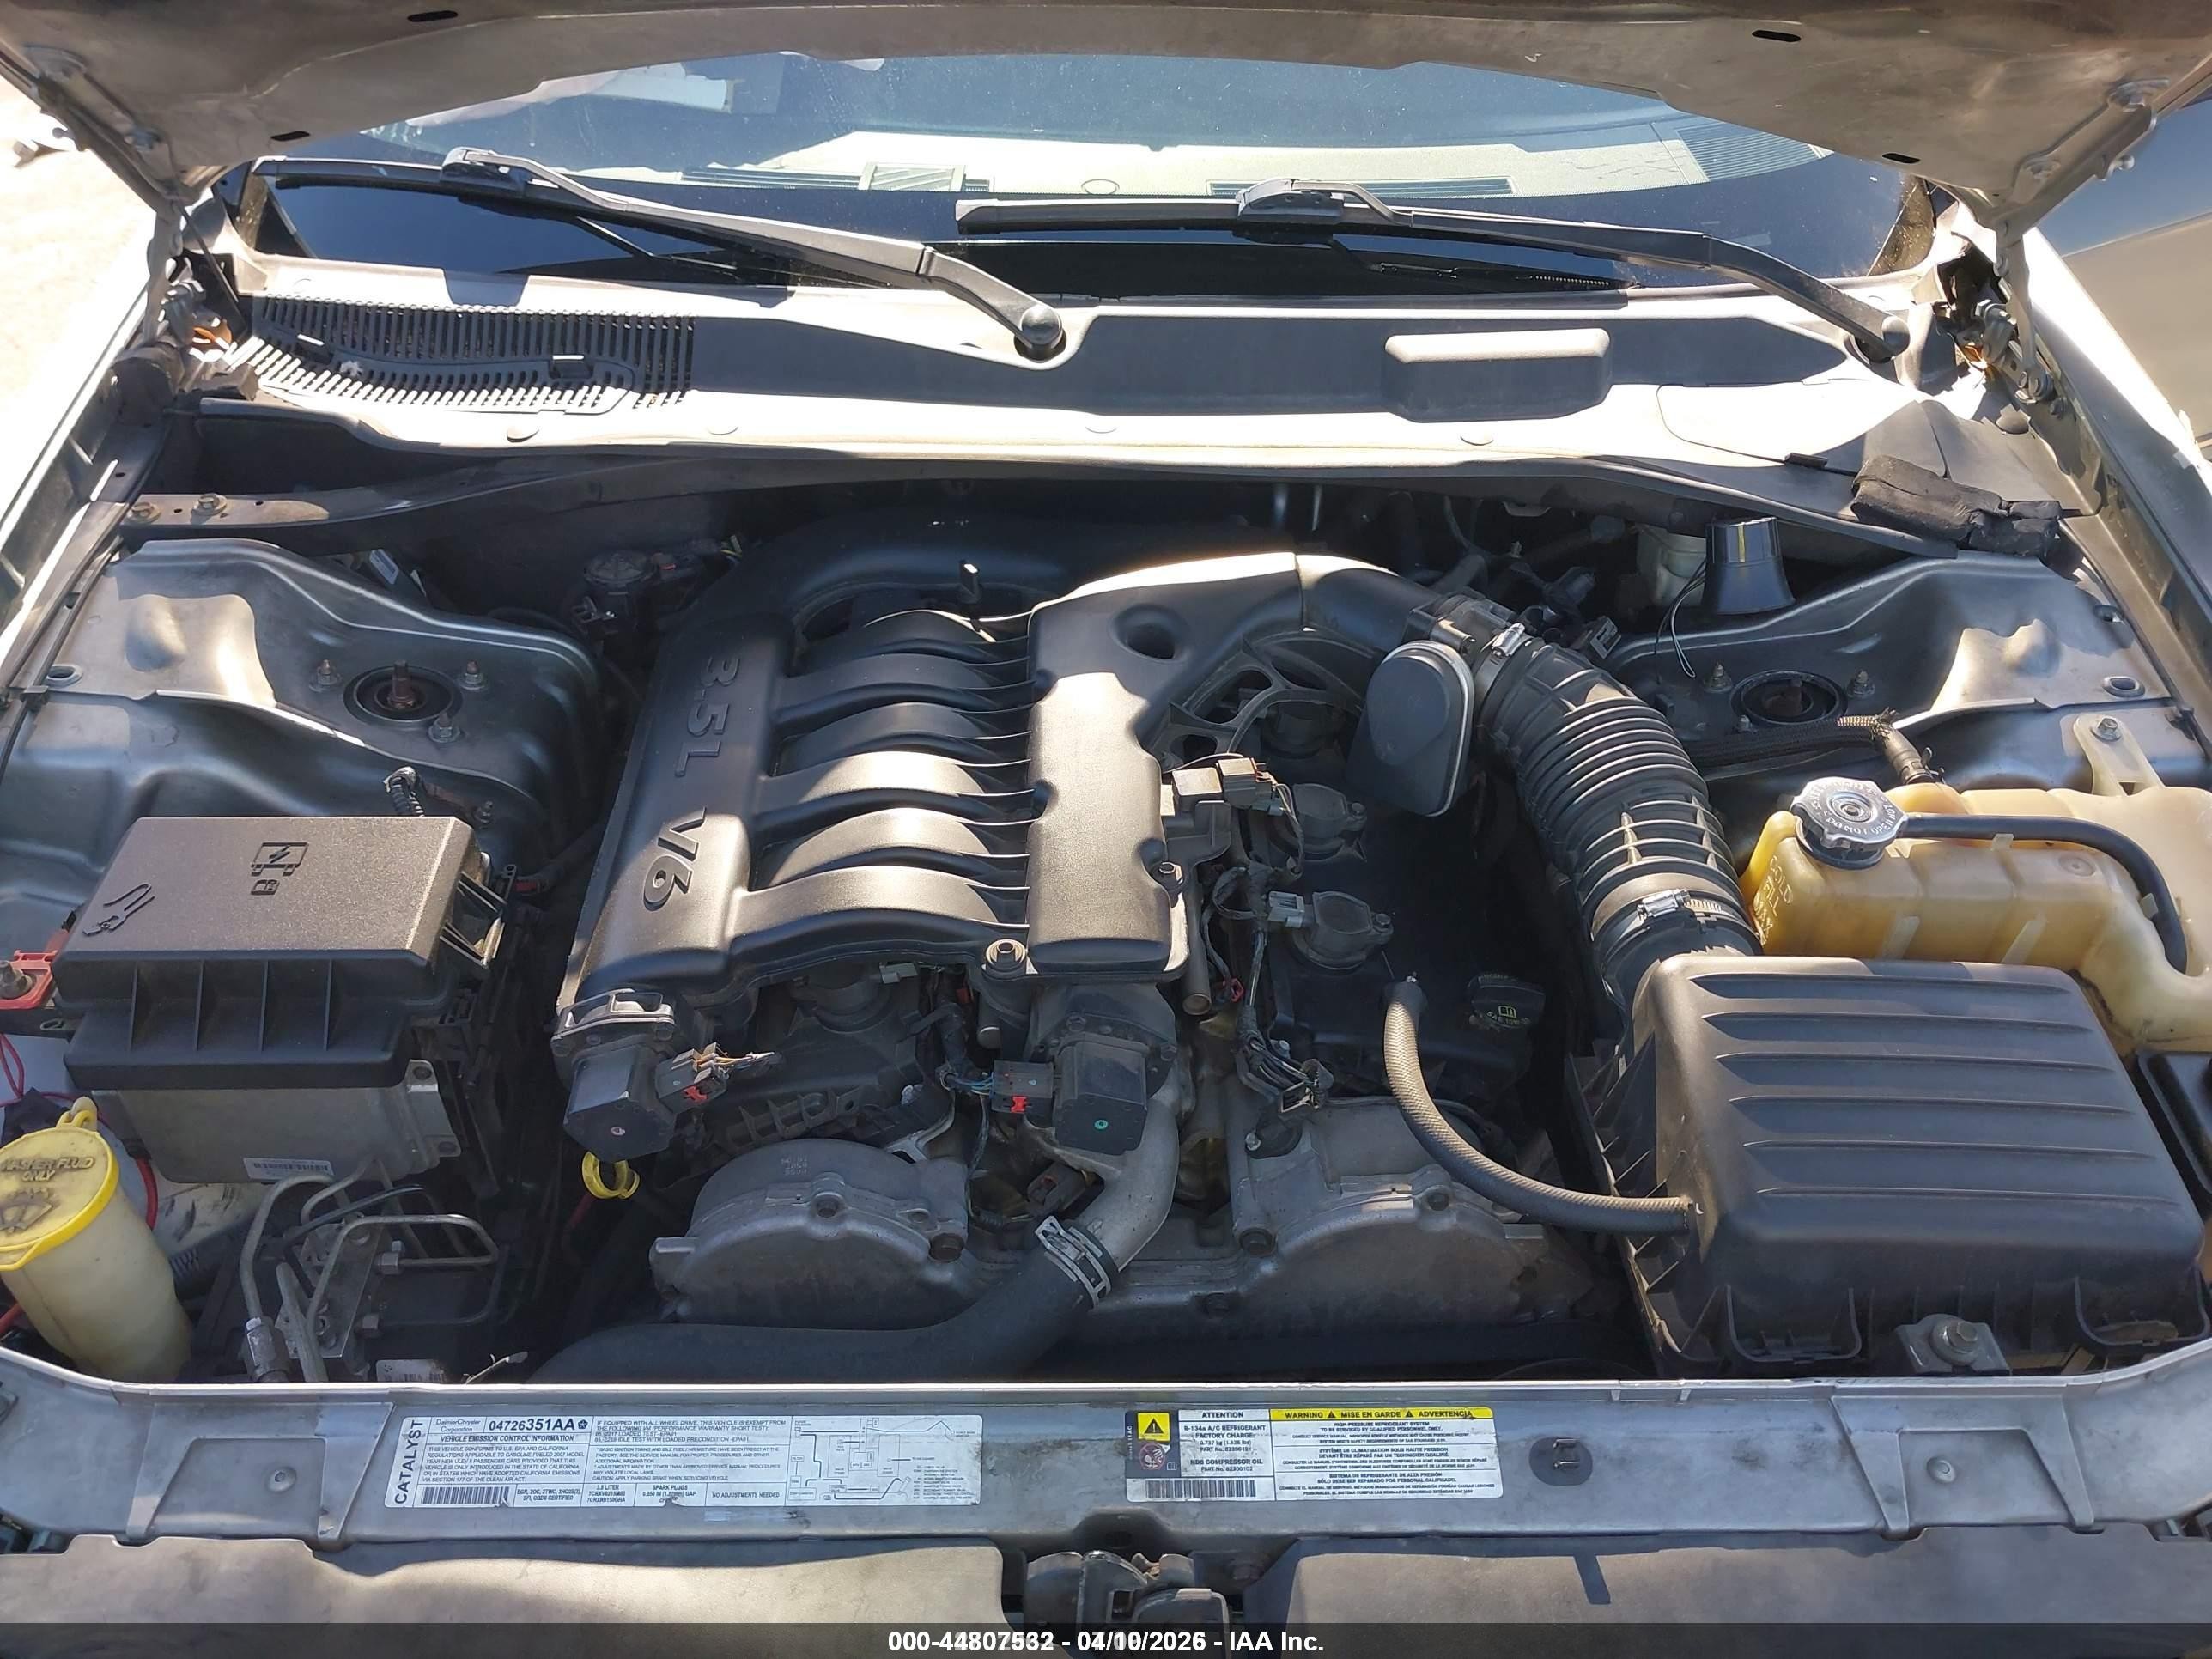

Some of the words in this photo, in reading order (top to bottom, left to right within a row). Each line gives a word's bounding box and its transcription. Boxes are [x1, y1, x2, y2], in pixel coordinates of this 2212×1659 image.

[675, 657, 741, 777] 3.5L
[642, 806, 706, 912] V6
[21, 1169, 56, 1182] ONLY
[56, 1157, 95, 1170] FLUID
[489, 1418, 574, 1431] 04726351AA
[395, 1419, 423, 1504] CATALYST
